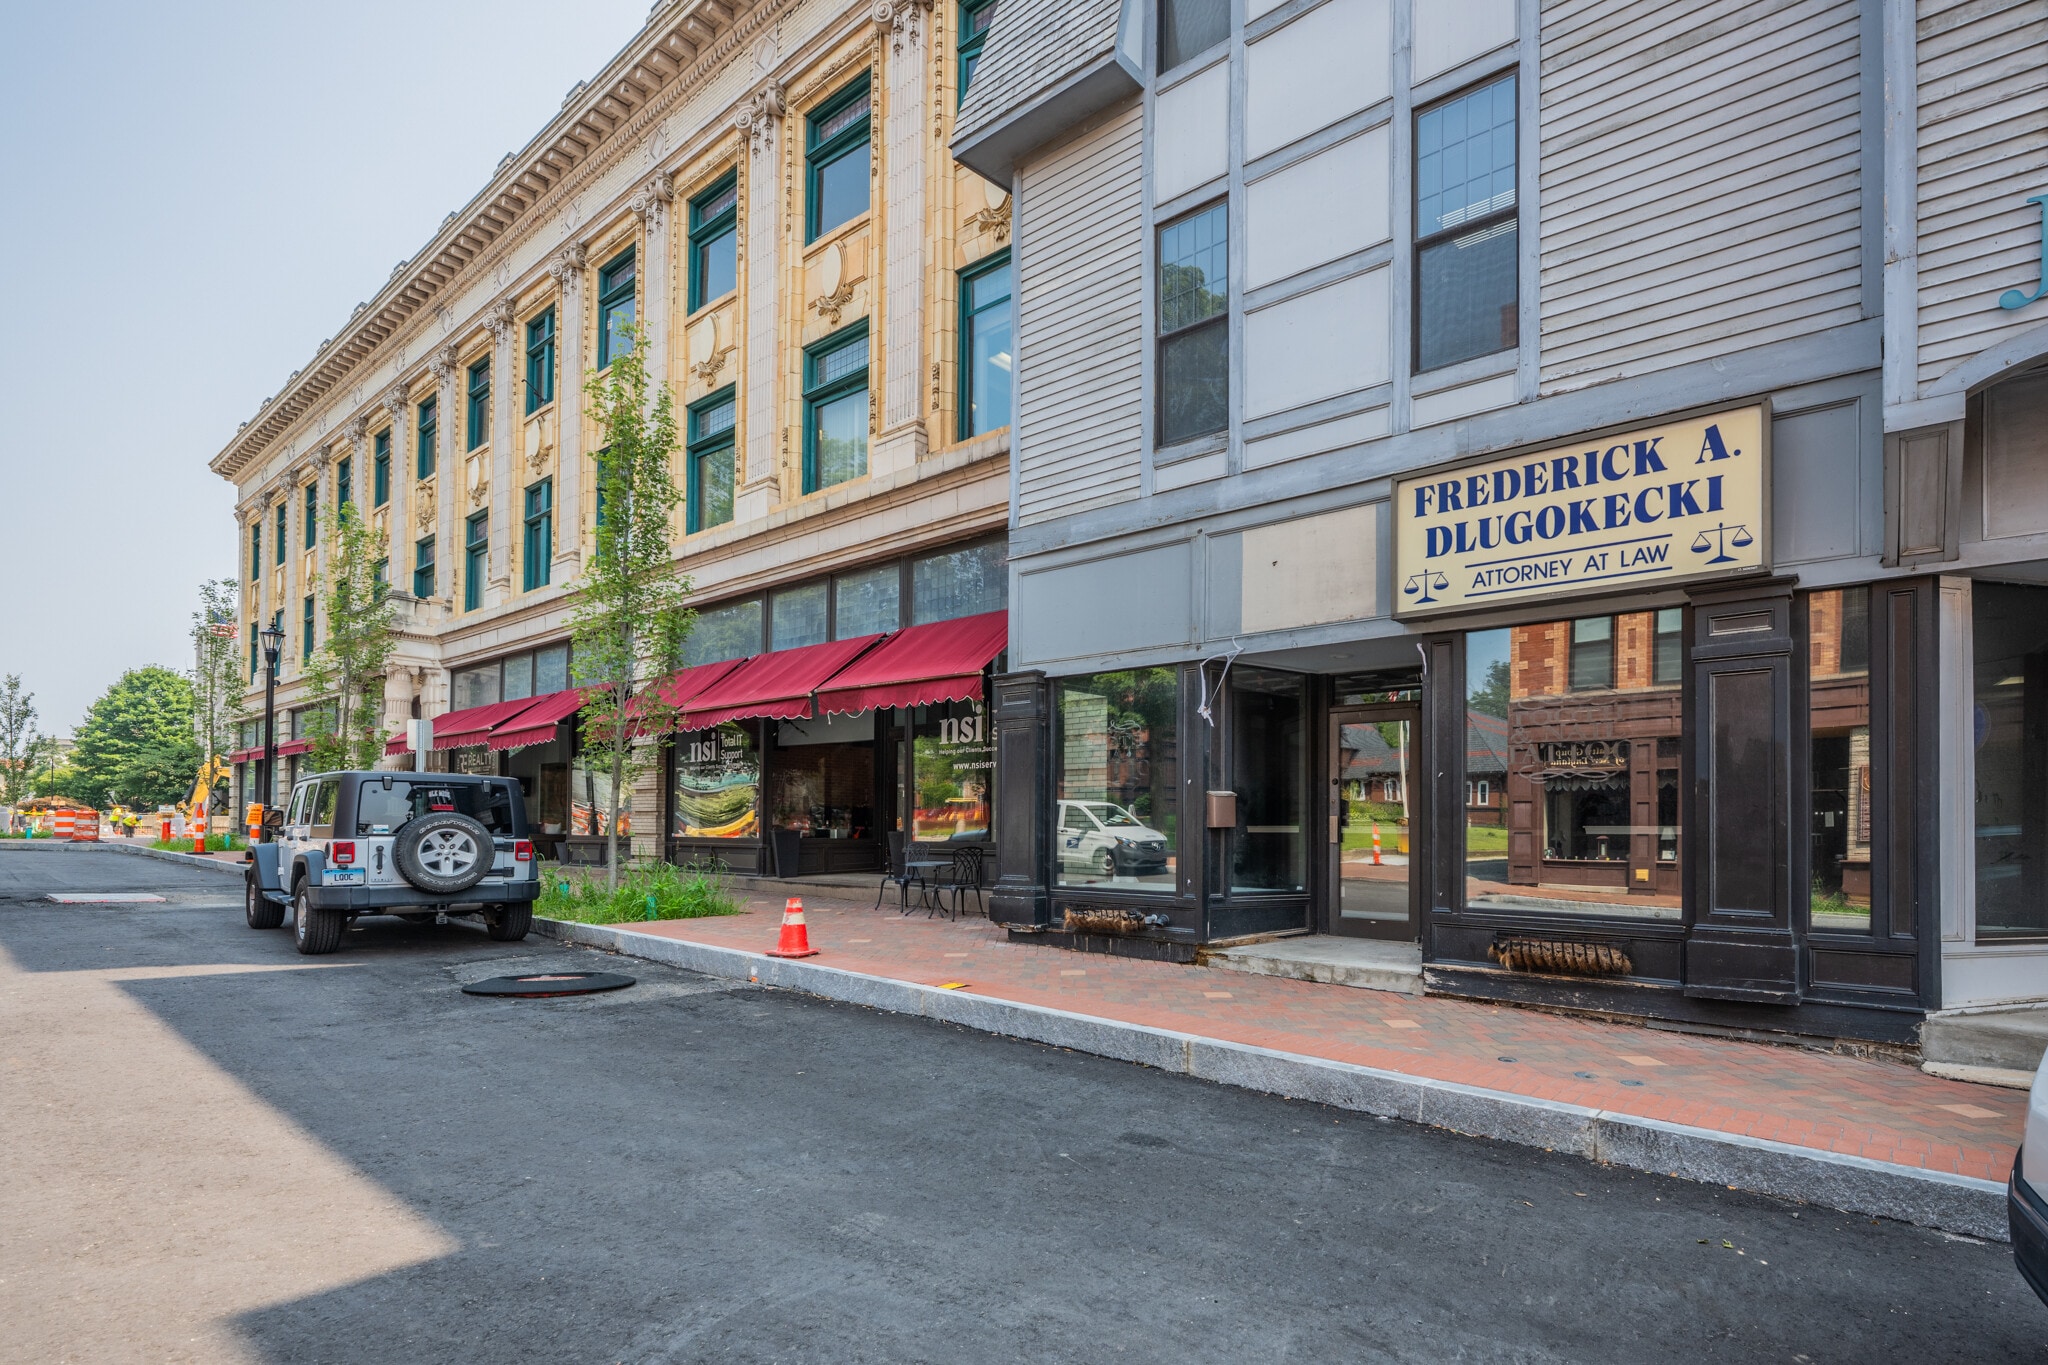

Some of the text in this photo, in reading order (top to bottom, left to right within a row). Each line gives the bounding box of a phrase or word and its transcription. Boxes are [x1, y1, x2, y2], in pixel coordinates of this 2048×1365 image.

[1414, 424, 1742, 518] FREDERICK A.
[1425, 474, 1725, 559] DLUGOKECKI
[1471, 543, 1670, 589] ATTORNEY AT LAW
[939, 704, 983, 745] nsi
[468, 752, 492, 767] REALTY
[690, 732, 717, 763] nsi
[721, 749, 743, 761] Support
[953, 760, 997, 770] www.nsiserv
